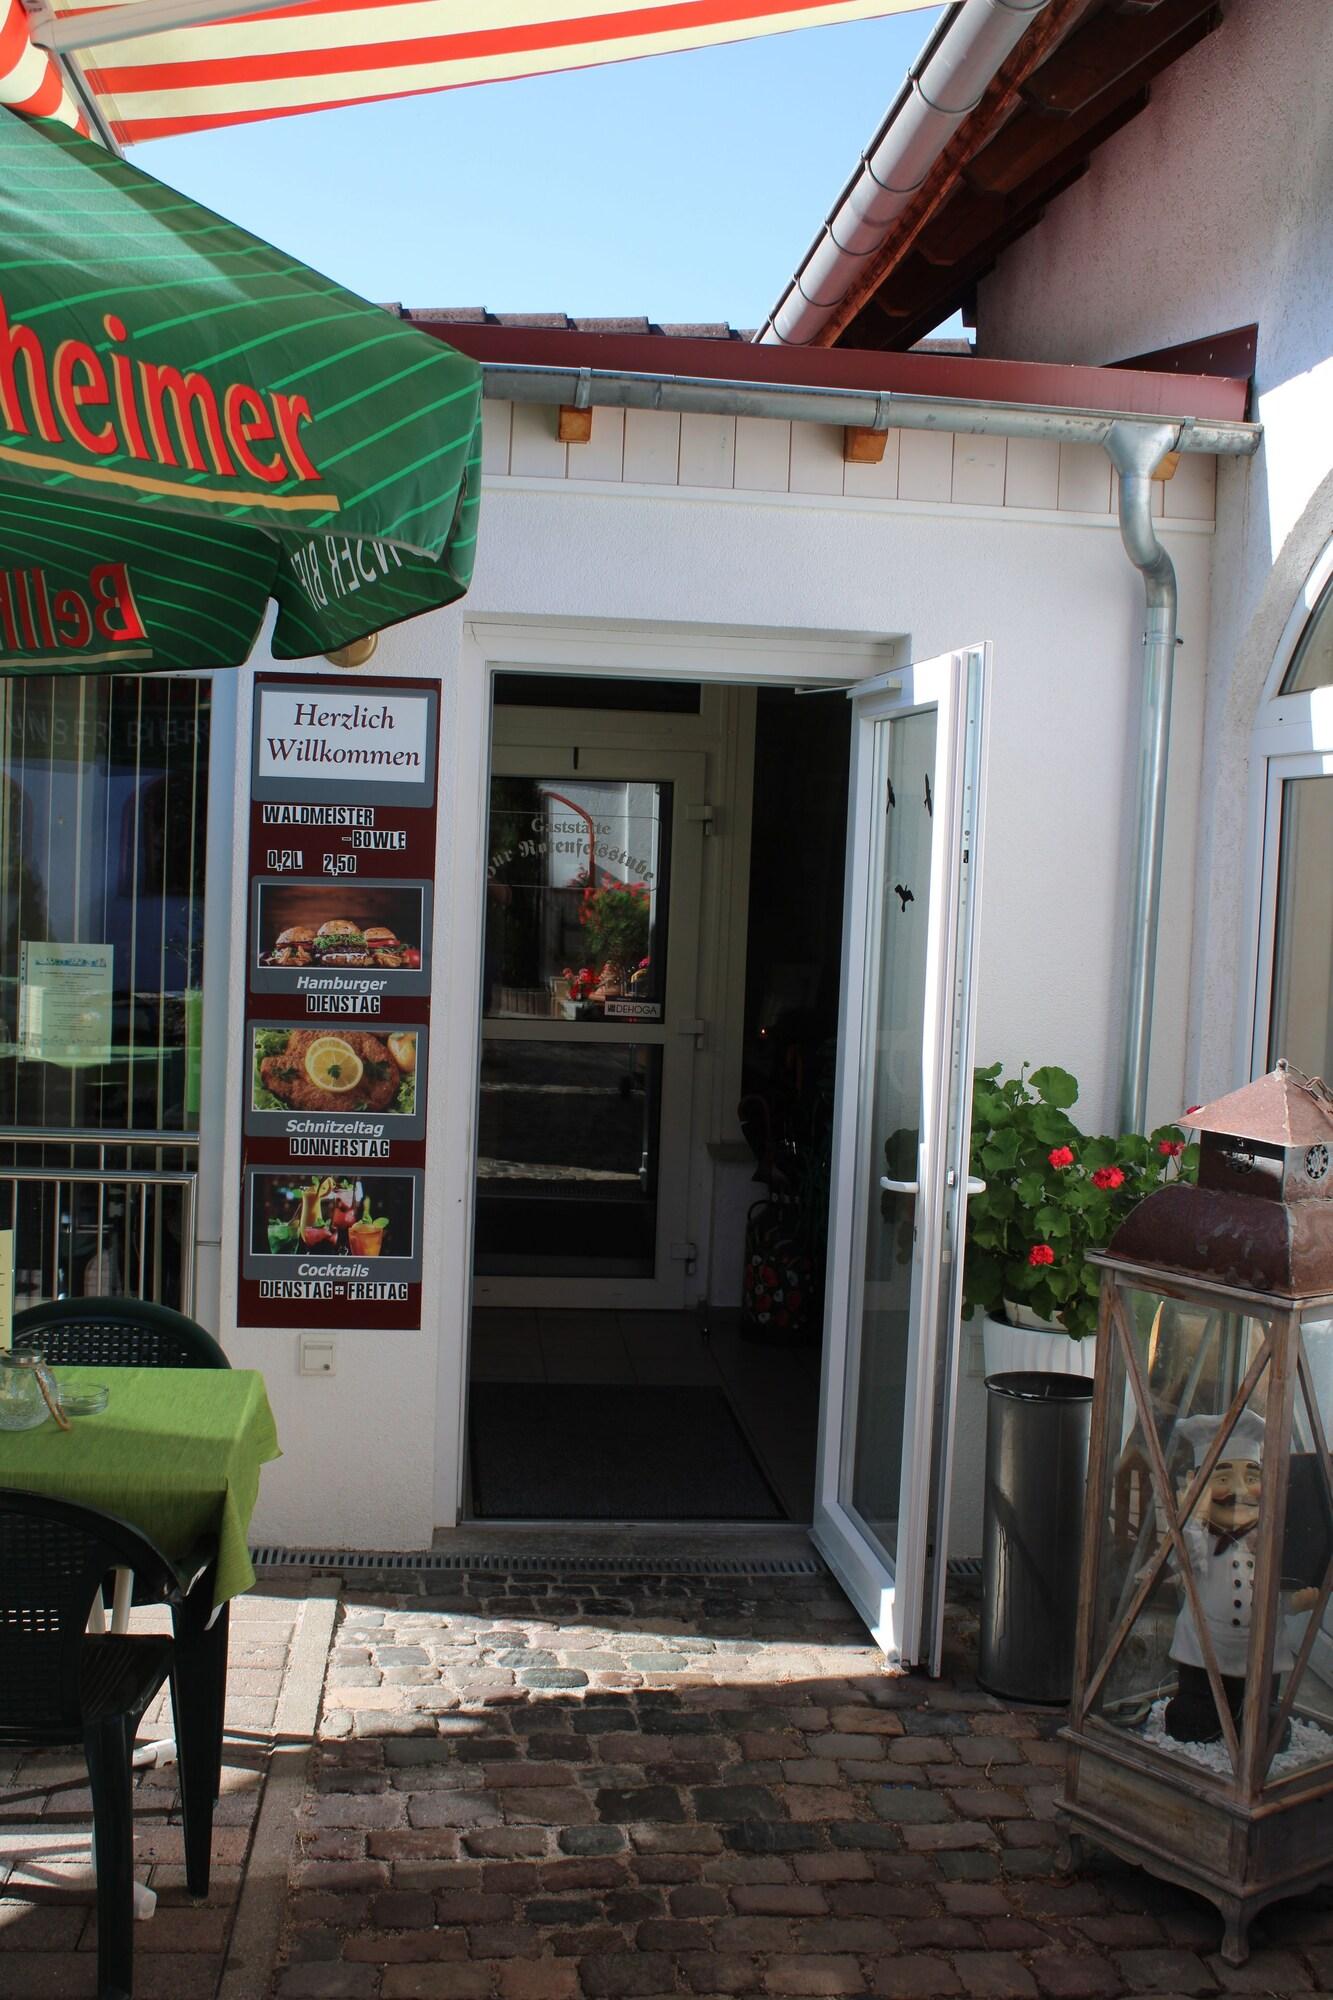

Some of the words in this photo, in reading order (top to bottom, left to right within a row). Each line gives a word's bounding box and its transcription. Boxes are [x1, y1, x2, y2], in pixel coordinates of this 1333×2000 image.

[0, 292, 322, 483] heimer
[294, 703, 394, 731] Herzlich
[267, 738, 421, 767] Willkommen
[264, 805, 373, 826] WALDMEISTER
[324, 854, 356, 875] 2,50
[297, 976, 387, 993] Hamburger
[307, 995, 380, 1013] DIENSTAG
[616, 1003, 657, 1015] DEHOGA
[285, 1119, 384, 1137] Schnitzeltag
[290, 1138, 389, 1157] DONNERSTAG
[297, 1263, 369, 1278] Cocktails
[260, 1280, 332, 1299] DIENSTAG
[348, 1283, 408, 1300] FREITAG
